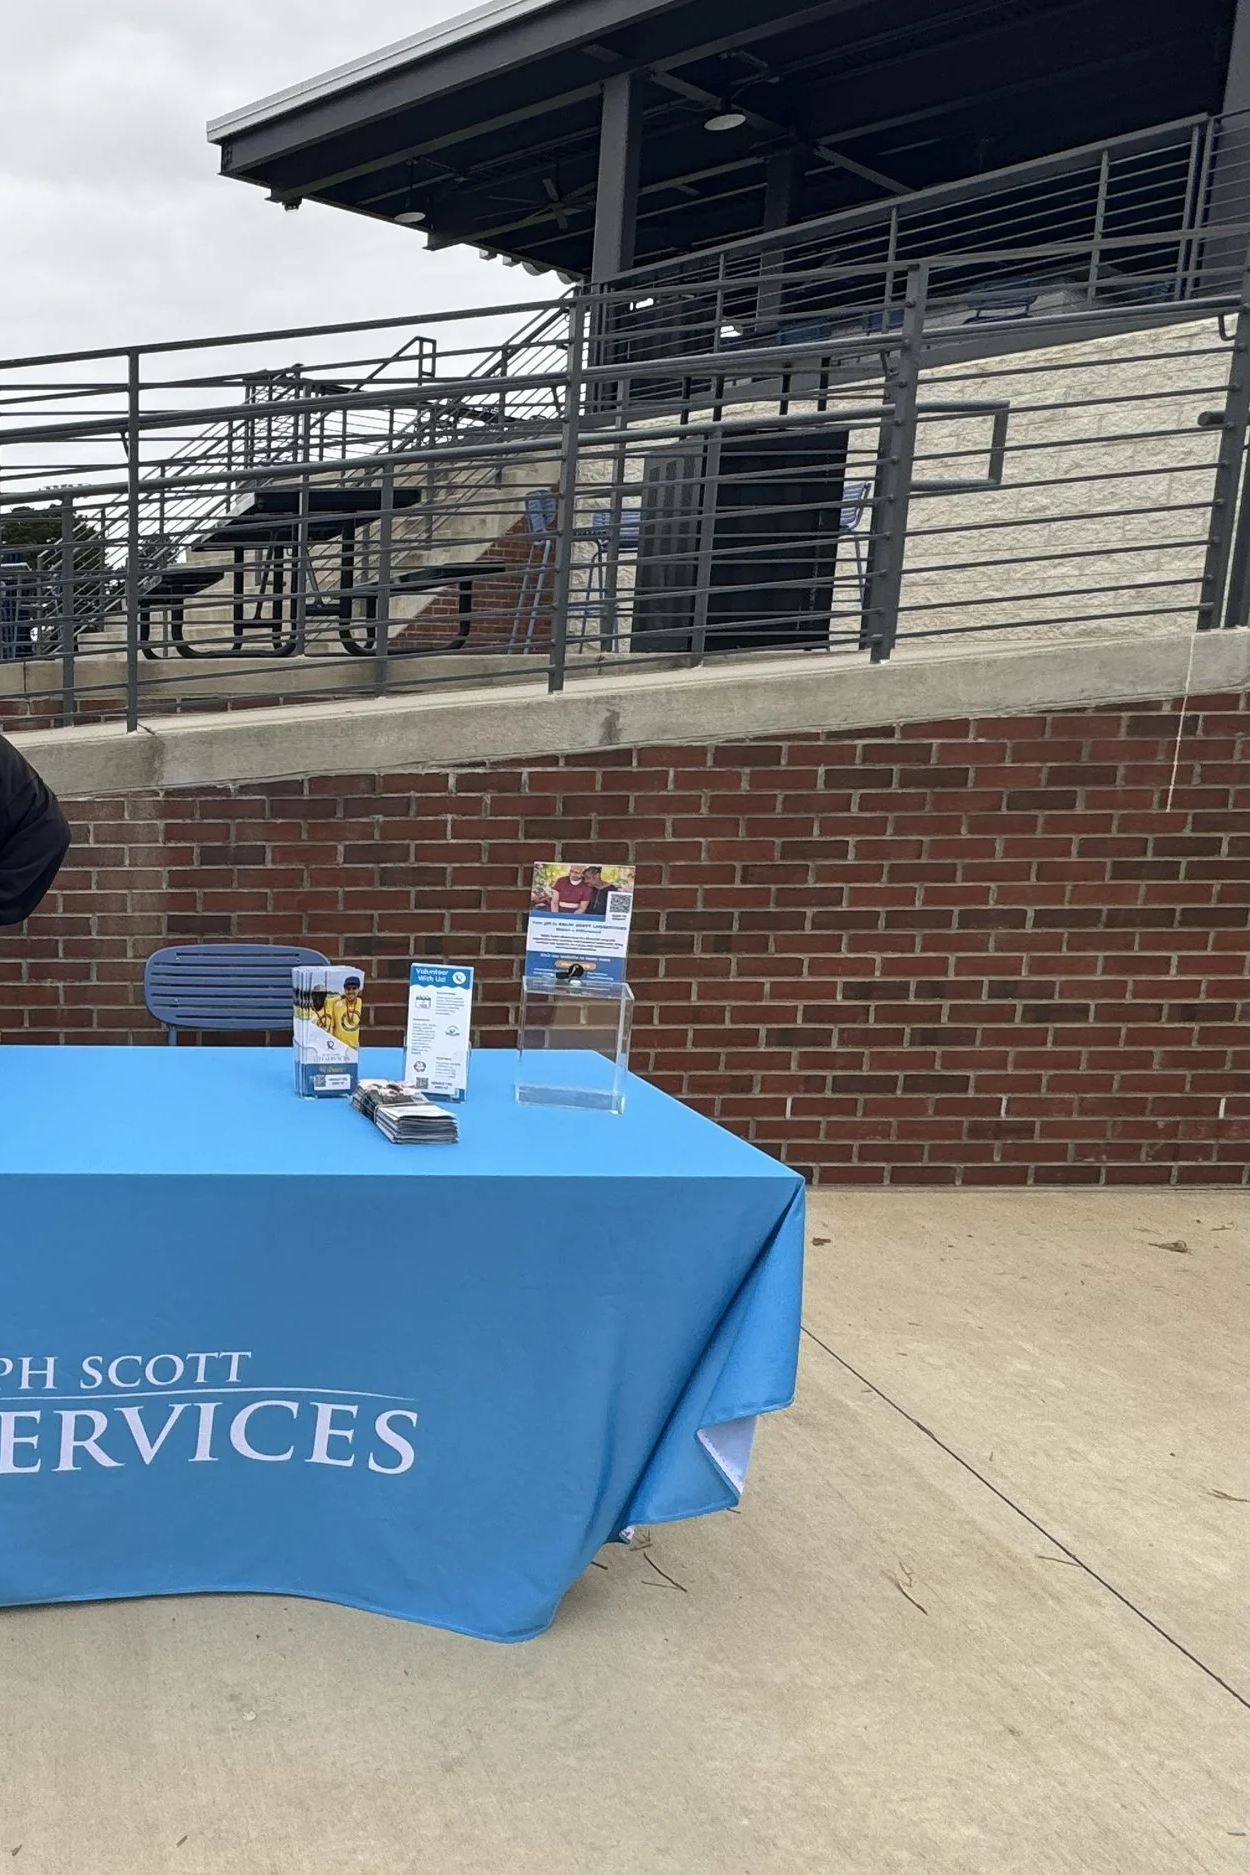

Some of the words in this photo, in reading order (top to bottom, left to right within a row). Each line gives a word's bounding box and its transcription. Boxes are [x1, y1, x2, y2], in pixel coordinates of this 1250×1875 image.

[415, 967, 449, 976] Volunteer
[417, 975, 434, 983] With
[80, 1351, 252, 1389] SCOTT
